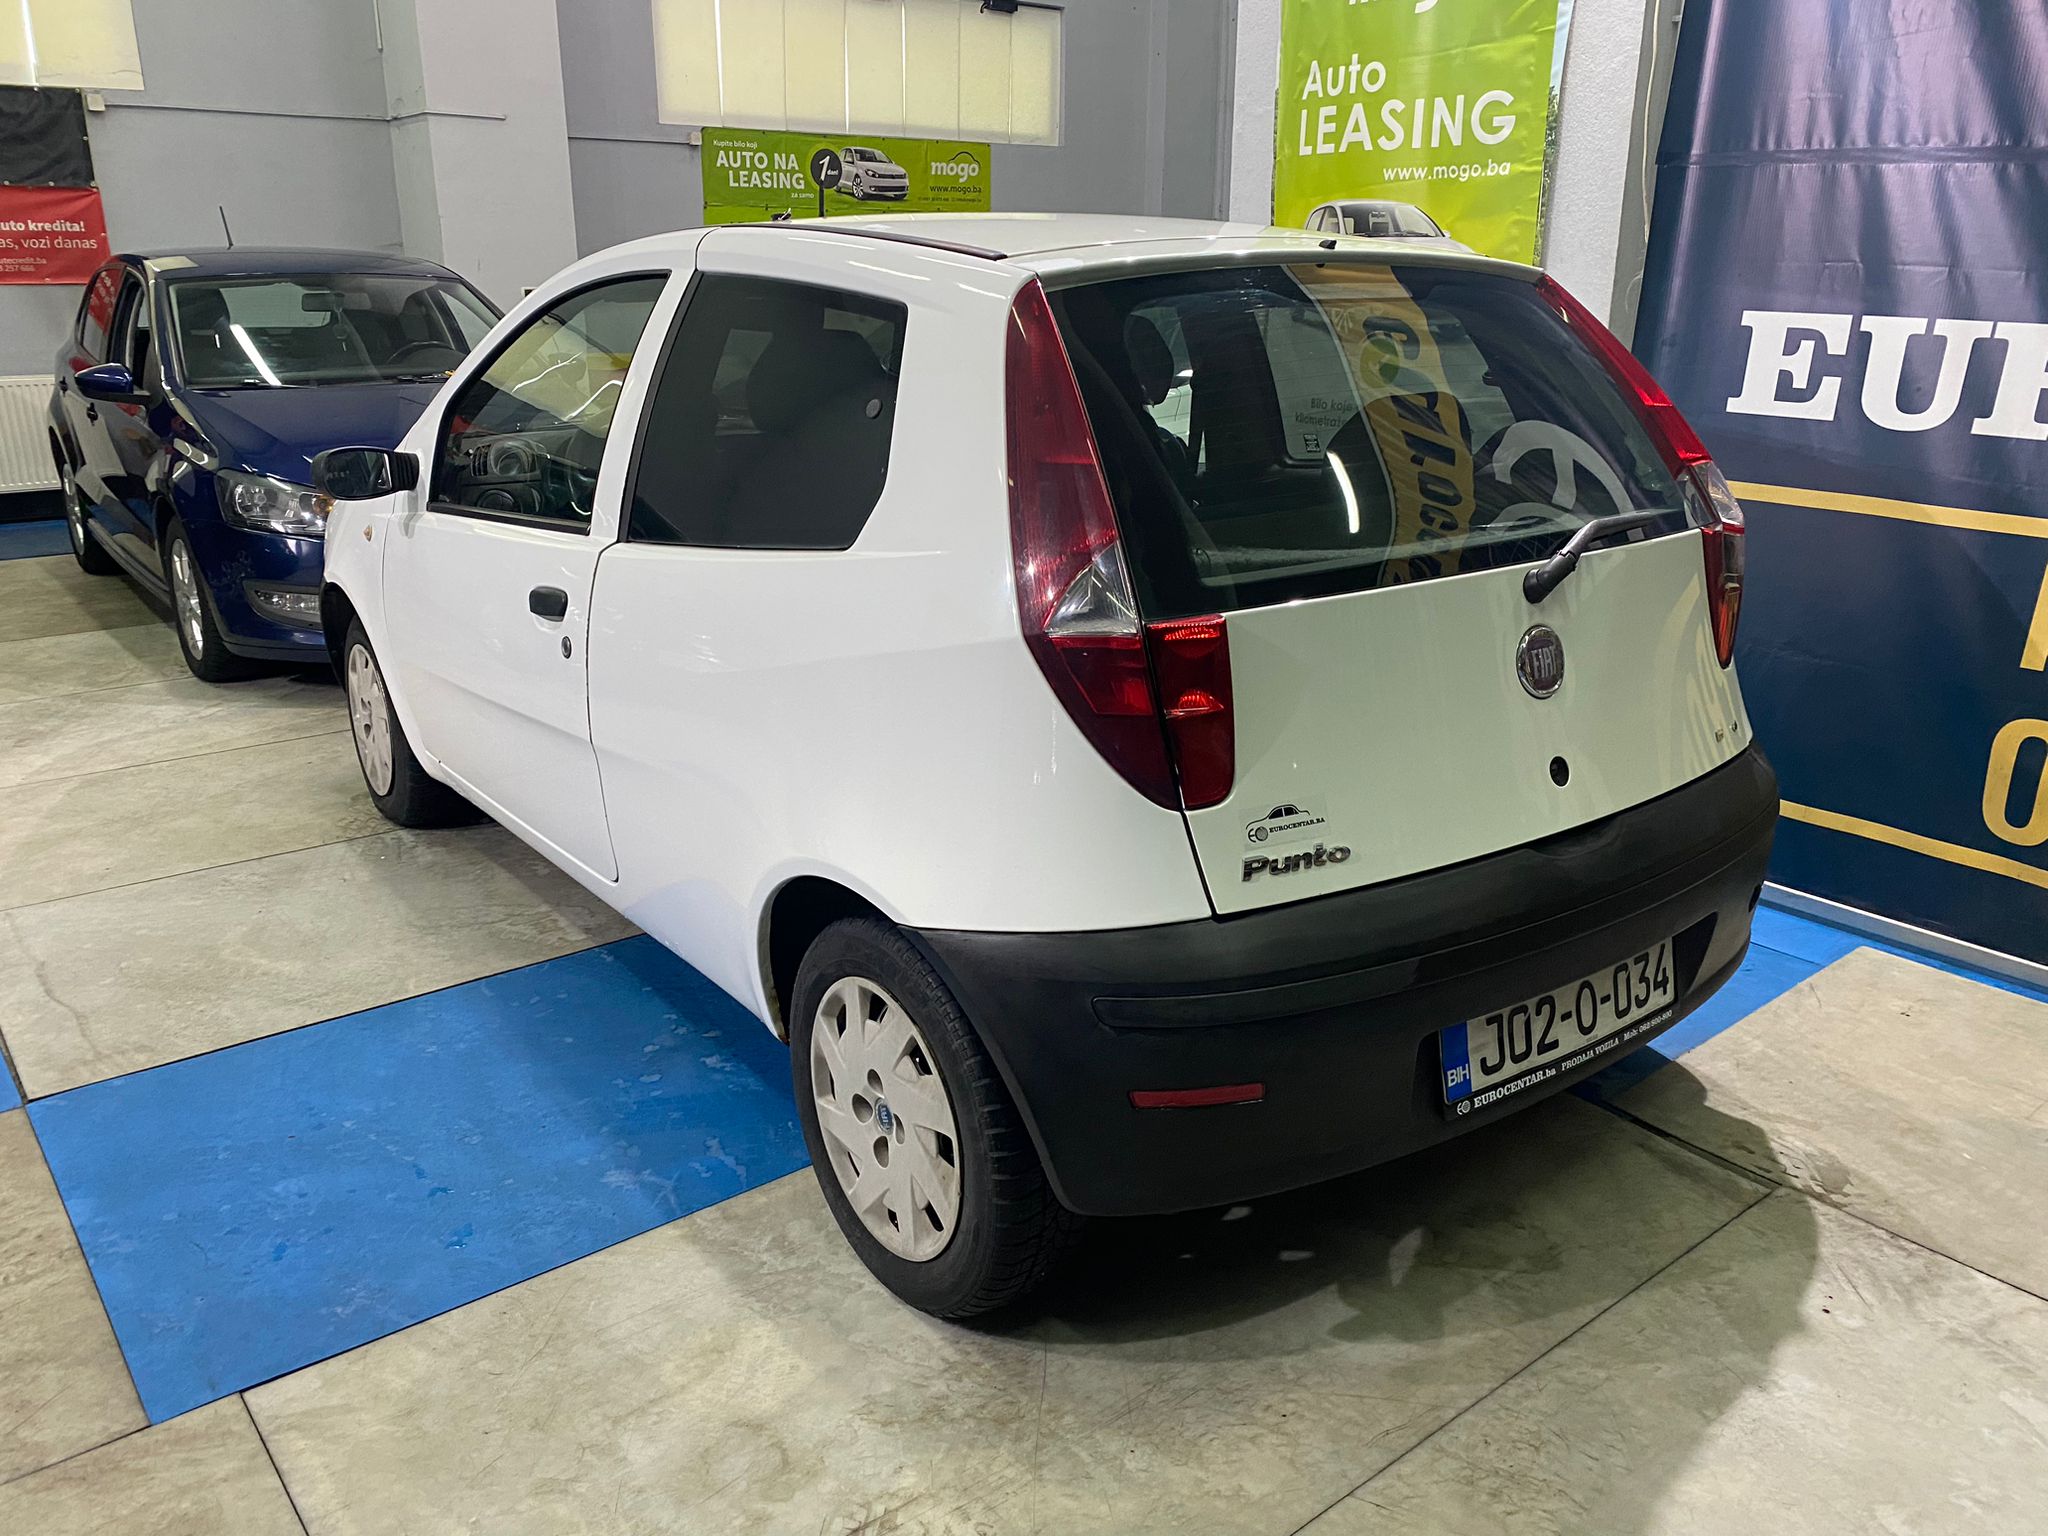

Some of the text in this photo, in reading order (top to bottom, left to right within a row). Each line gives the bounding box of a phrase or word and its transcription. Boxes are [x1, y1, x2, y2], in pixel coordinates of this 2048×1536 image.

[1302, 54, 1386, 100] Auto
[1299, 90, 1516, 156] LEASING
[716, 151, 799, 170] AUTO NA
[819, 155, 830, 181] 1
[930, 161, 979, 183] mogo
[1383, 159, 1511, 182] www.mogo.ba
[728, 170, 805, 190] LEASING
[930, 185, 982, 195] www.mogo.ba
[28, 220, 86, 232] kredita!
[21, 236, 51, 248] vozi
[54, 236, 98, 249] danas
[1531, 647, 1557, 679] FIAT
[1269, 817, 1326, 833] EUROCENTAR.BA
[1241, 843, 1351, 882] Punto
[1447, 1063, 1470, 1088] BIH
[1474, 1068, 1556, 1108] EUROCENTAR.ba
[1561, 1050, 1594, 1071] PRODAJA
